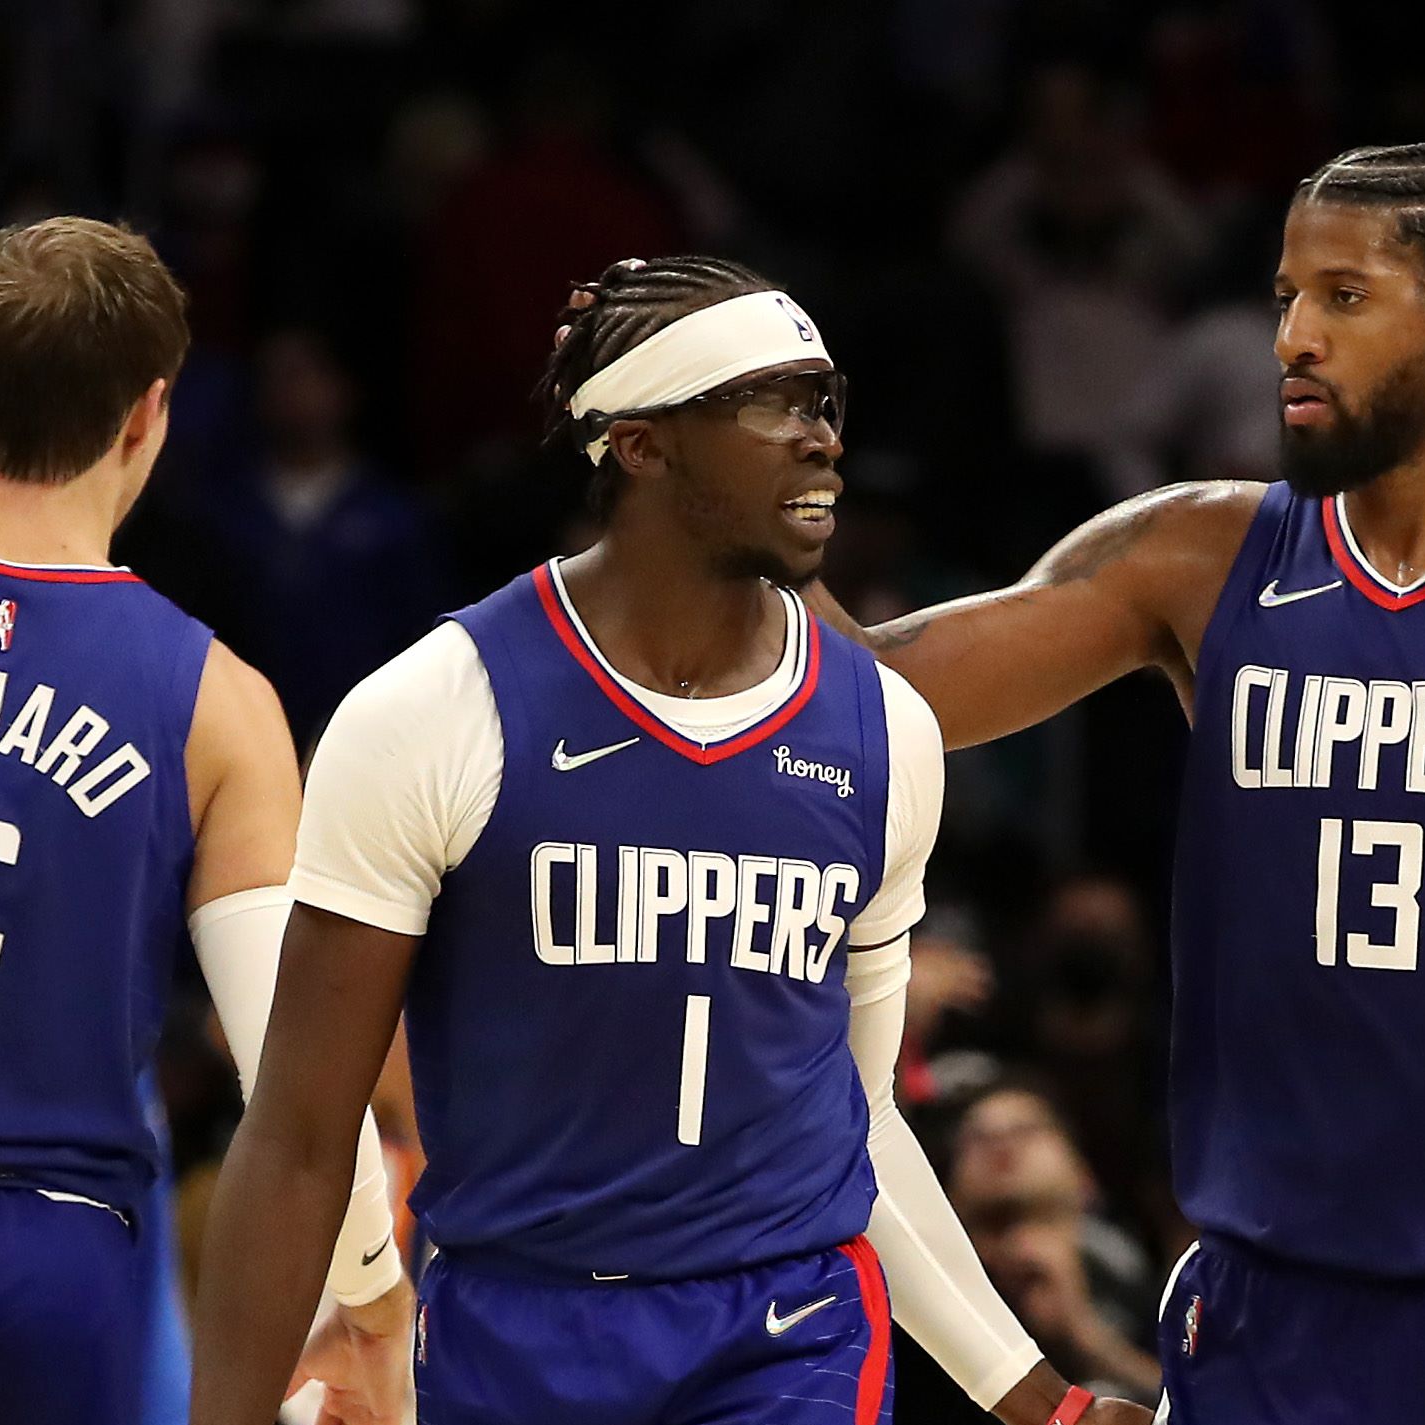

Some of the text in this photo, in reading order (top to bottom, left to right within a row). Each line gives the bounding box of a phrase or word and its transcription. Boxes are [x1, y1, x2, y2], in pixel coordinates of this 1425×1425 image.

[772, 745, 855, 798] honey
[528, 840, 860, 984] CLIPPERS
[1314, 817, 1424, 971] 13
[677, 994, 710, 1147] 1
